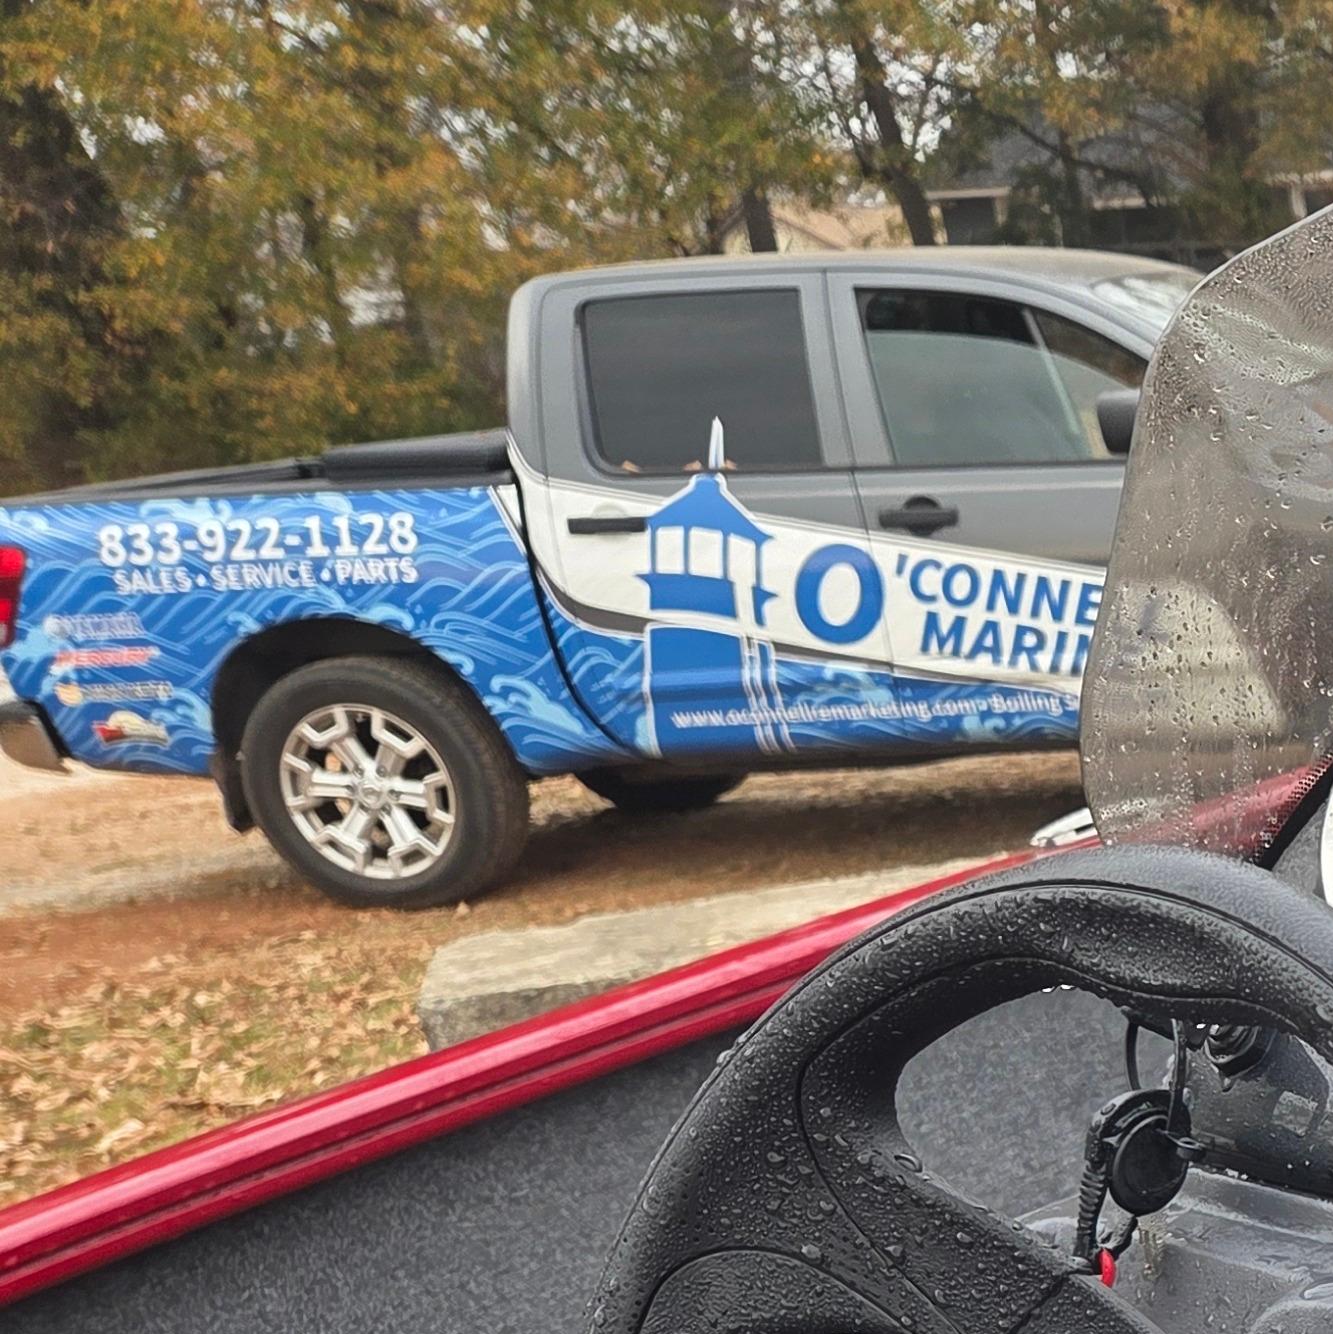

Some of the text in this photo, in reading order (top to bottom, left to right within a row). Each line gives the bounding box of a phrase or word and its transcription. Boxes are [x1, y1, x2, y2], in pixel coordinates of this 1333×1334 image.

[98, 511, 419, 568] 833-922-1128
[112, 556, 419, 595] SALES SERVICE PARTS
